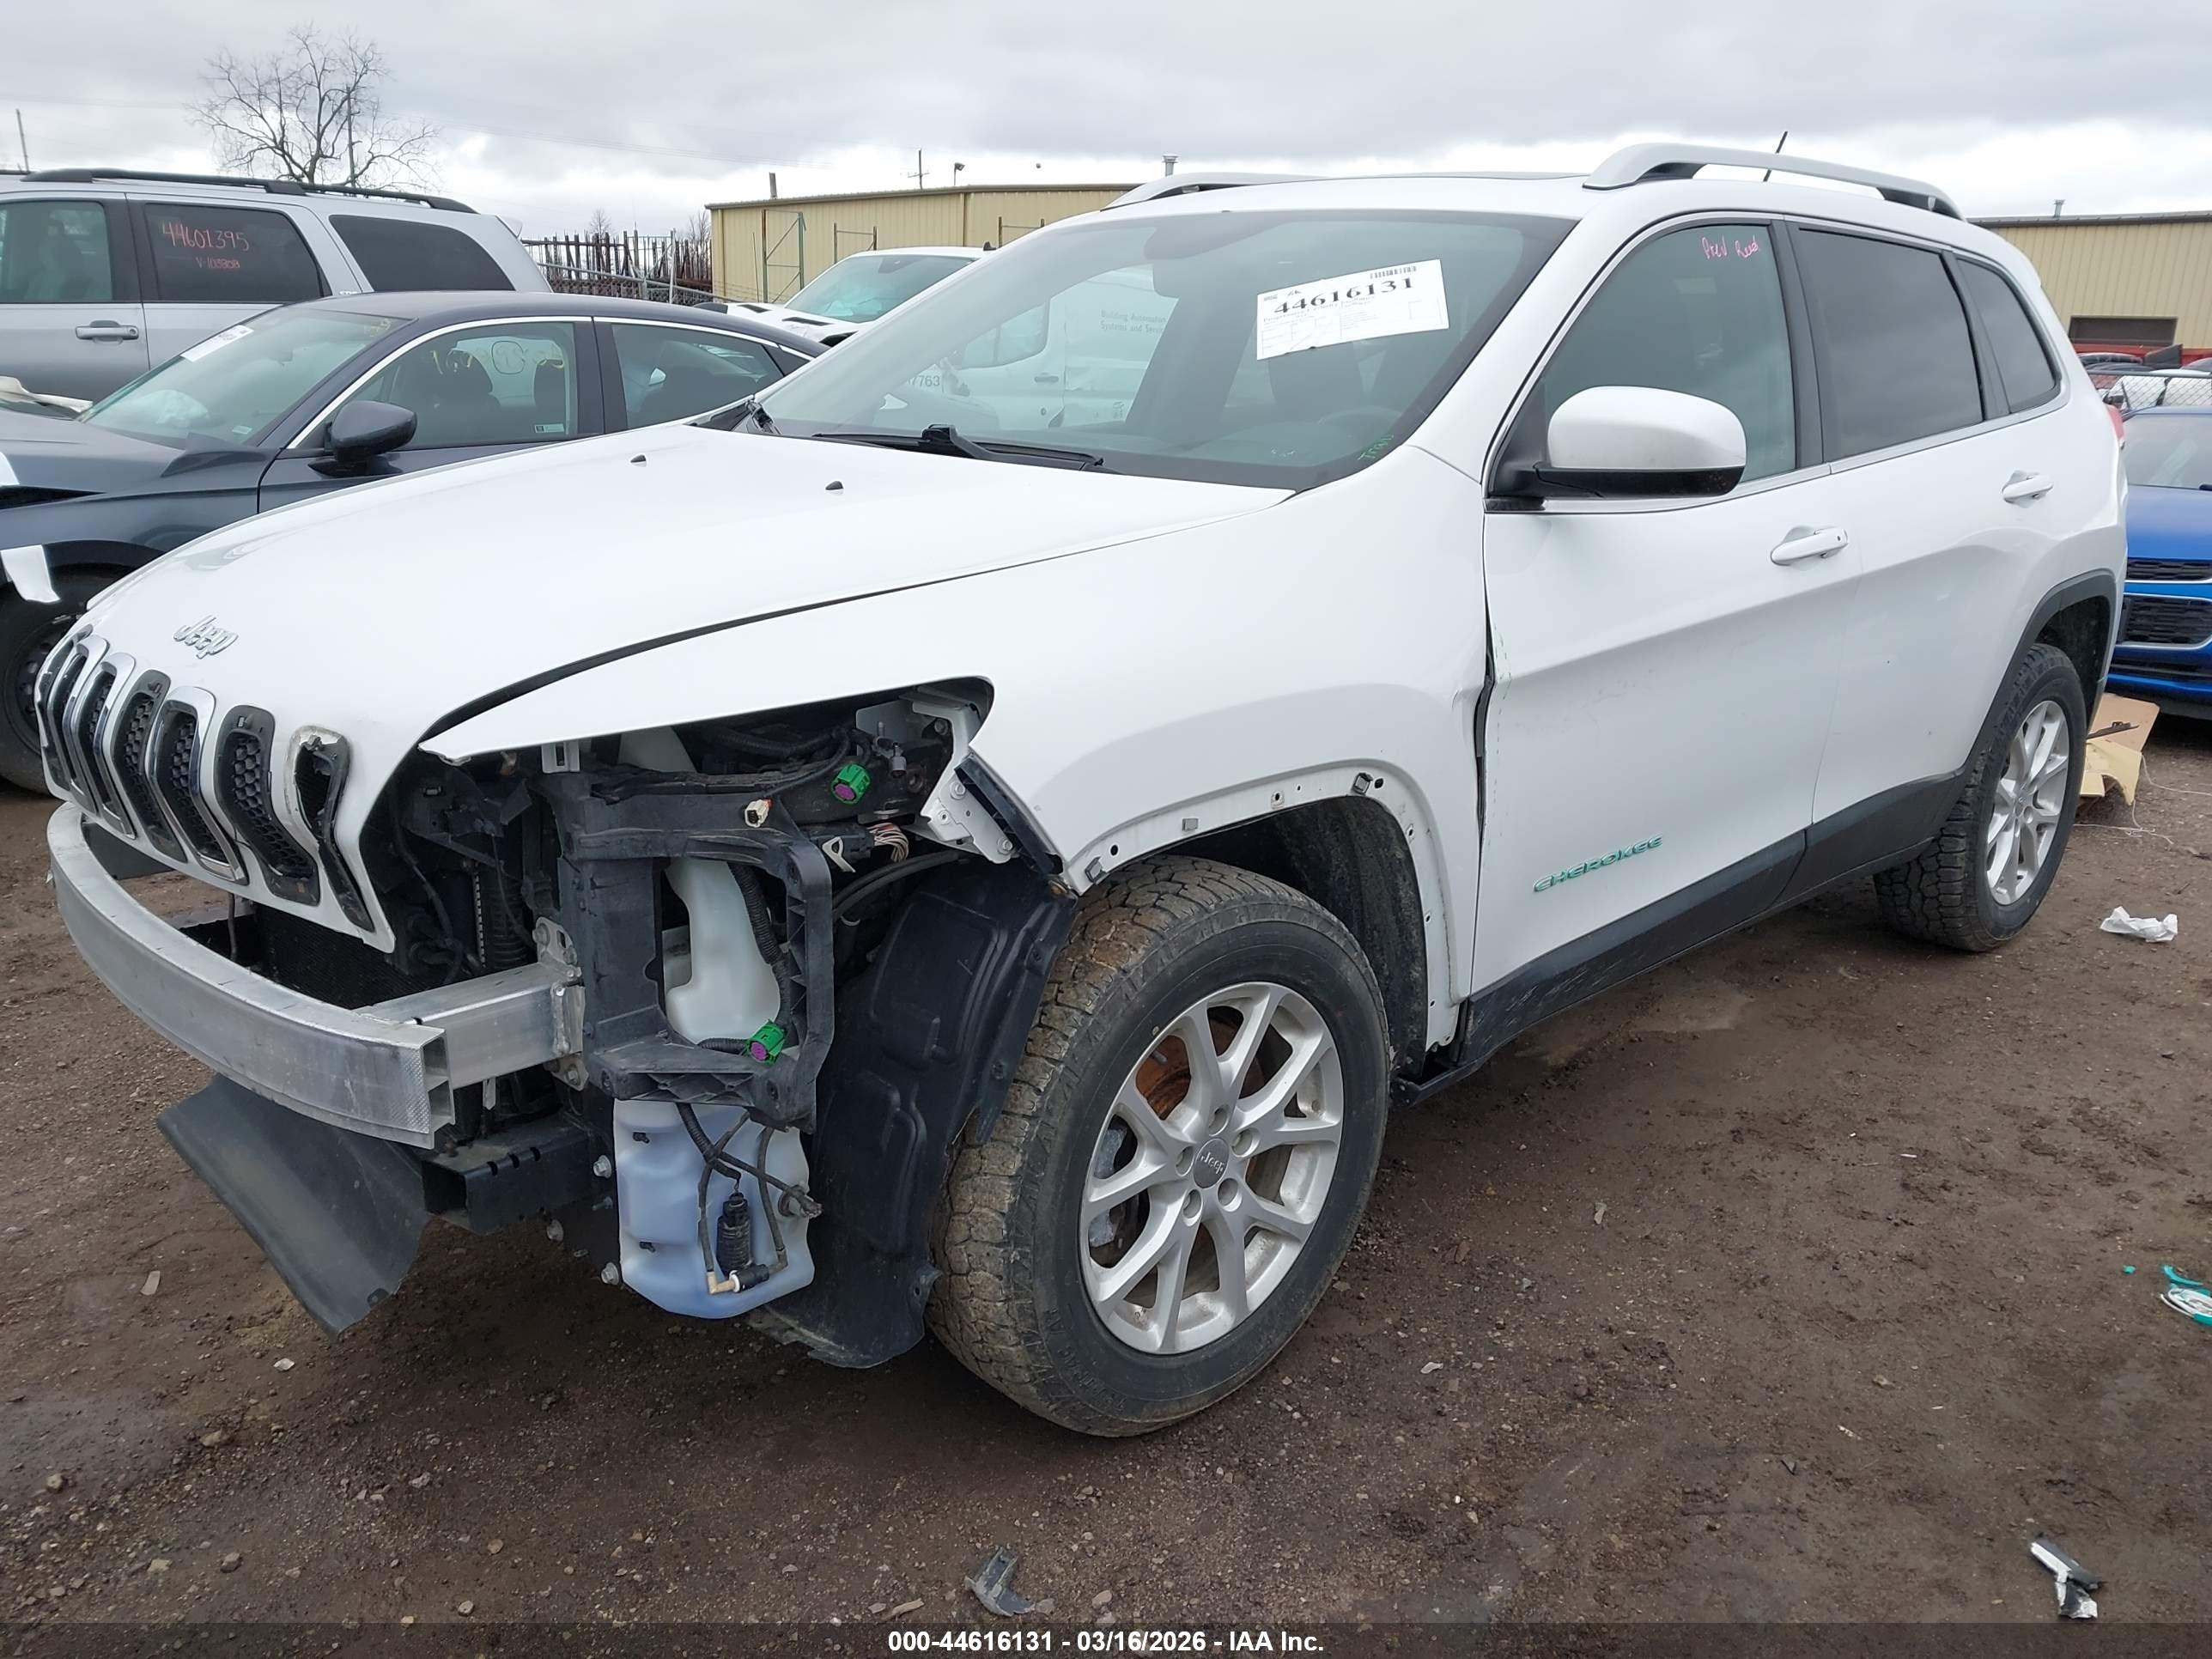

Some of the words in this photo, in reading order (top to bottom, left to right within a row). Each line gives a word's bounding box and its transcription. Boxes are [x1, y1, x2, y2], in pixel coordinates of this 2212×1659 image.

[161, 220, 250, 252] 44601395
[1273, 276, 1414, 314] 44616131
[1130, 323, 1142, 332] and
[173, 615, 239, 659] Jeep
[1533, 834, 1663, 892] CHEROKEE
[1200, 1152, 1224, 1175] Jeep
